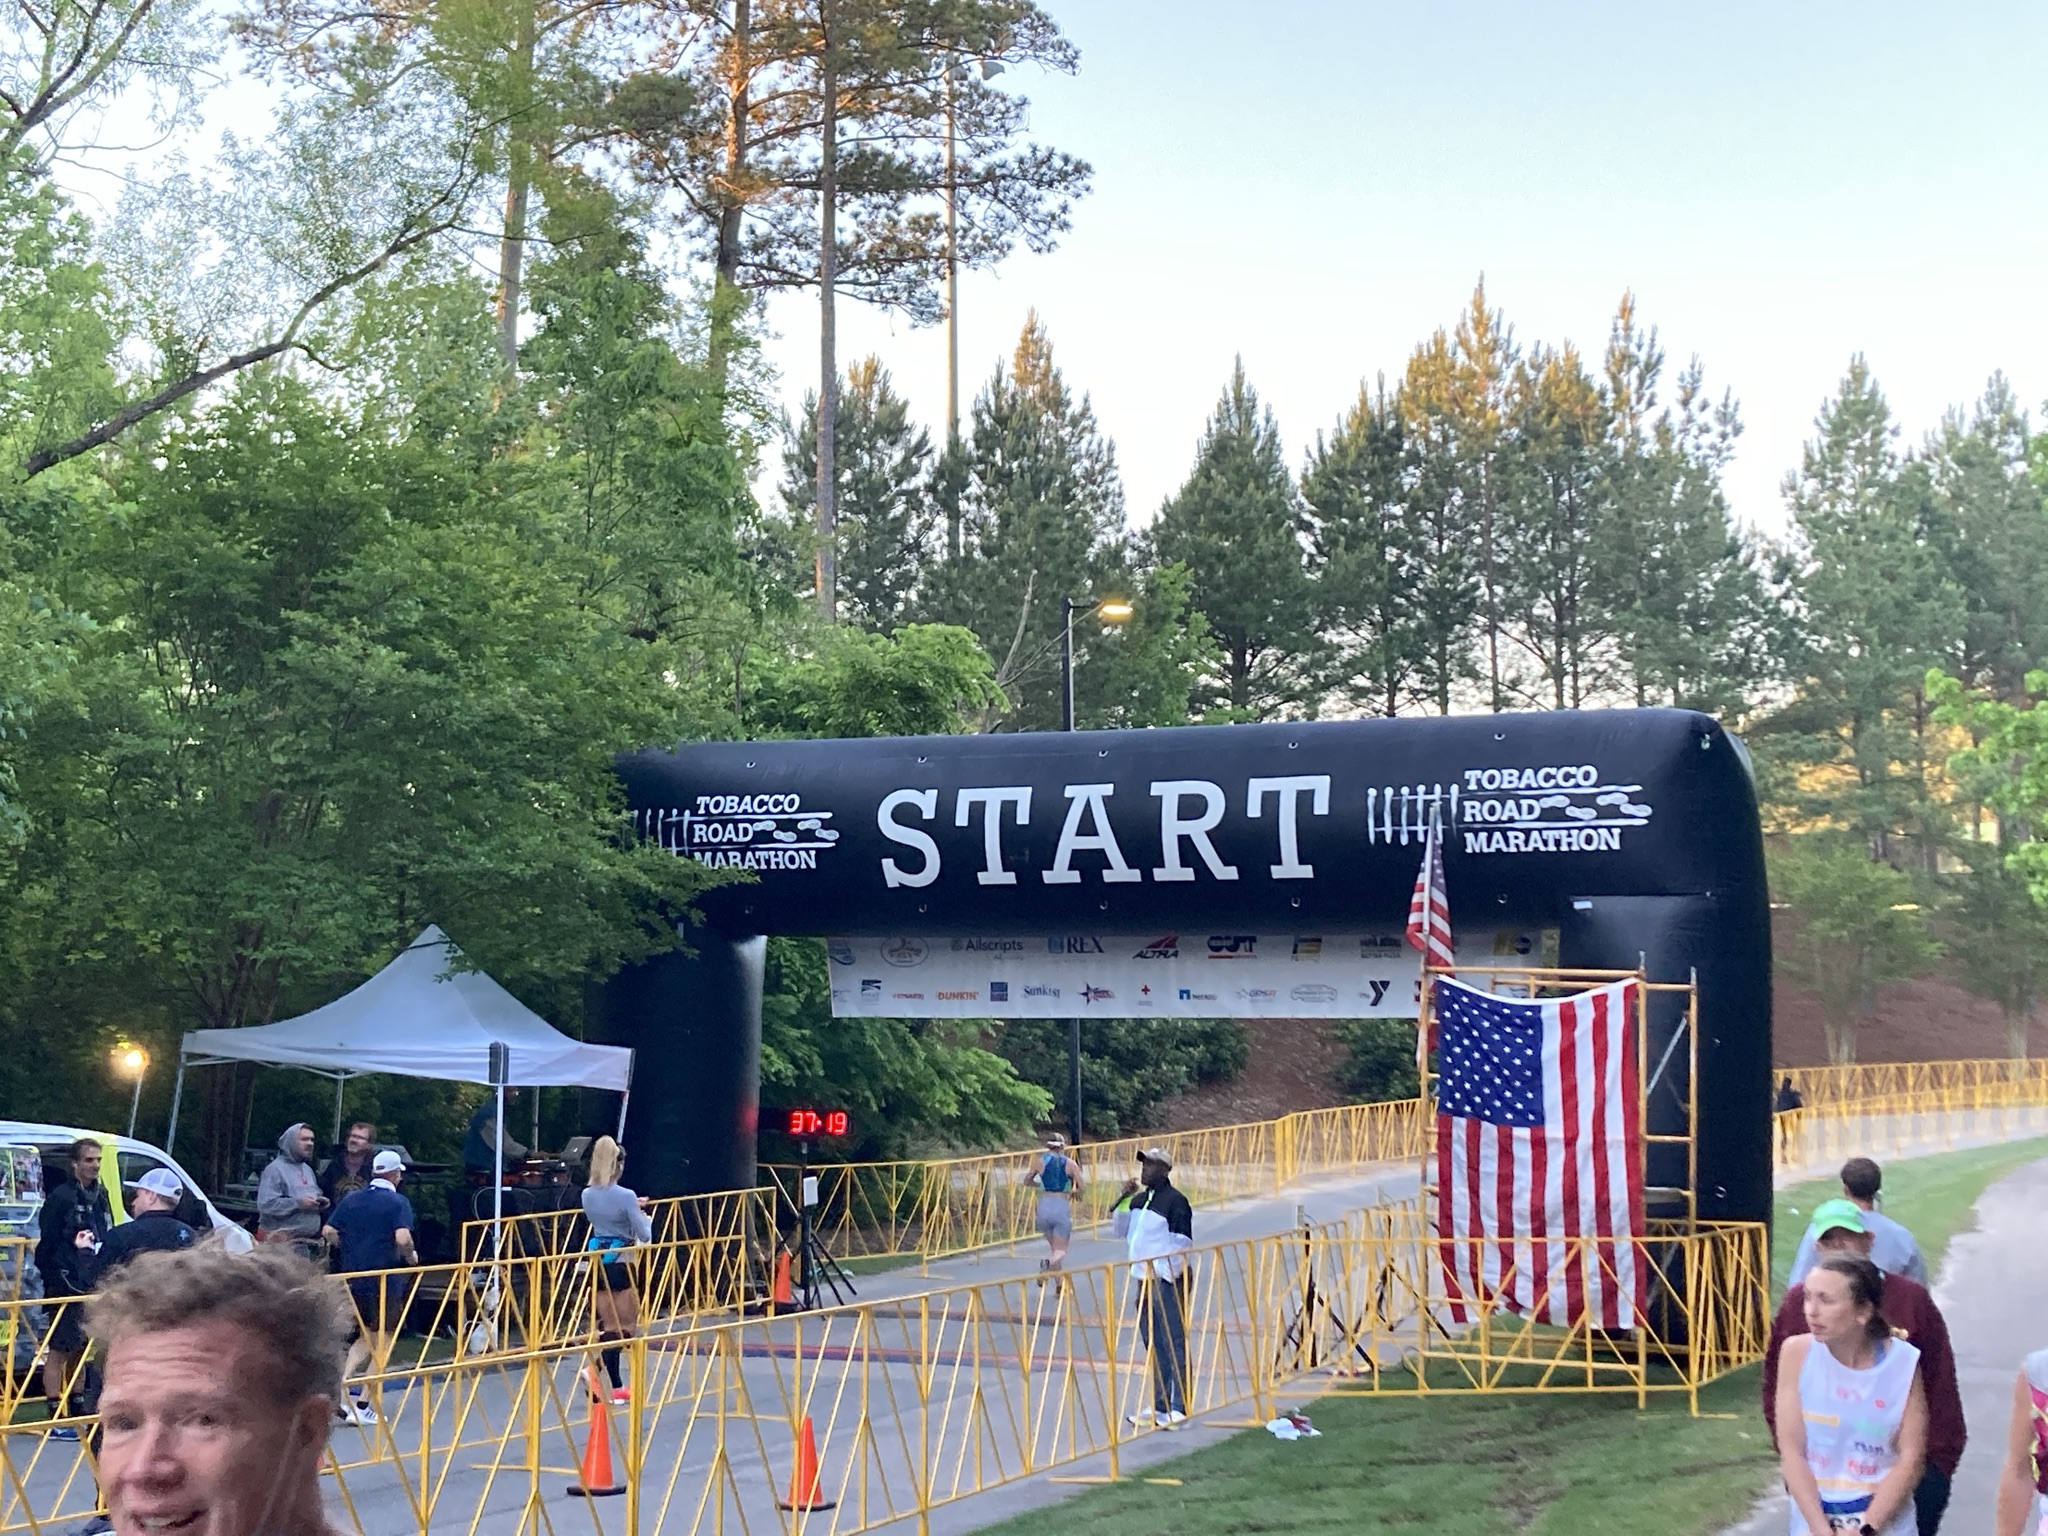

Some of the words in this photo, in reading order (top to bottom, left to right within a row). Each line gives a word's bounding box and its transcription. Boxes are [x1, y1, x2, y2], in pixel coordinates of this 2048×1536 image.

[1464, 765, 1598, 790] TOBACCO
[696, 793, 801, 815] TOBACCO
[1463, 799, 1541, 822] ROAD
[693, 822, 754, 844] ROAD
[877, 775, 1331, 888] START
[1464, 828, 1622, 854] MARATHON
[693, 850, 817, 870] MARATHON
[965, 938, 1024, 953] Allscripts
[1066, 936, 1105, 954] REX
[1132, 949, 1180, 959] ALTRA
